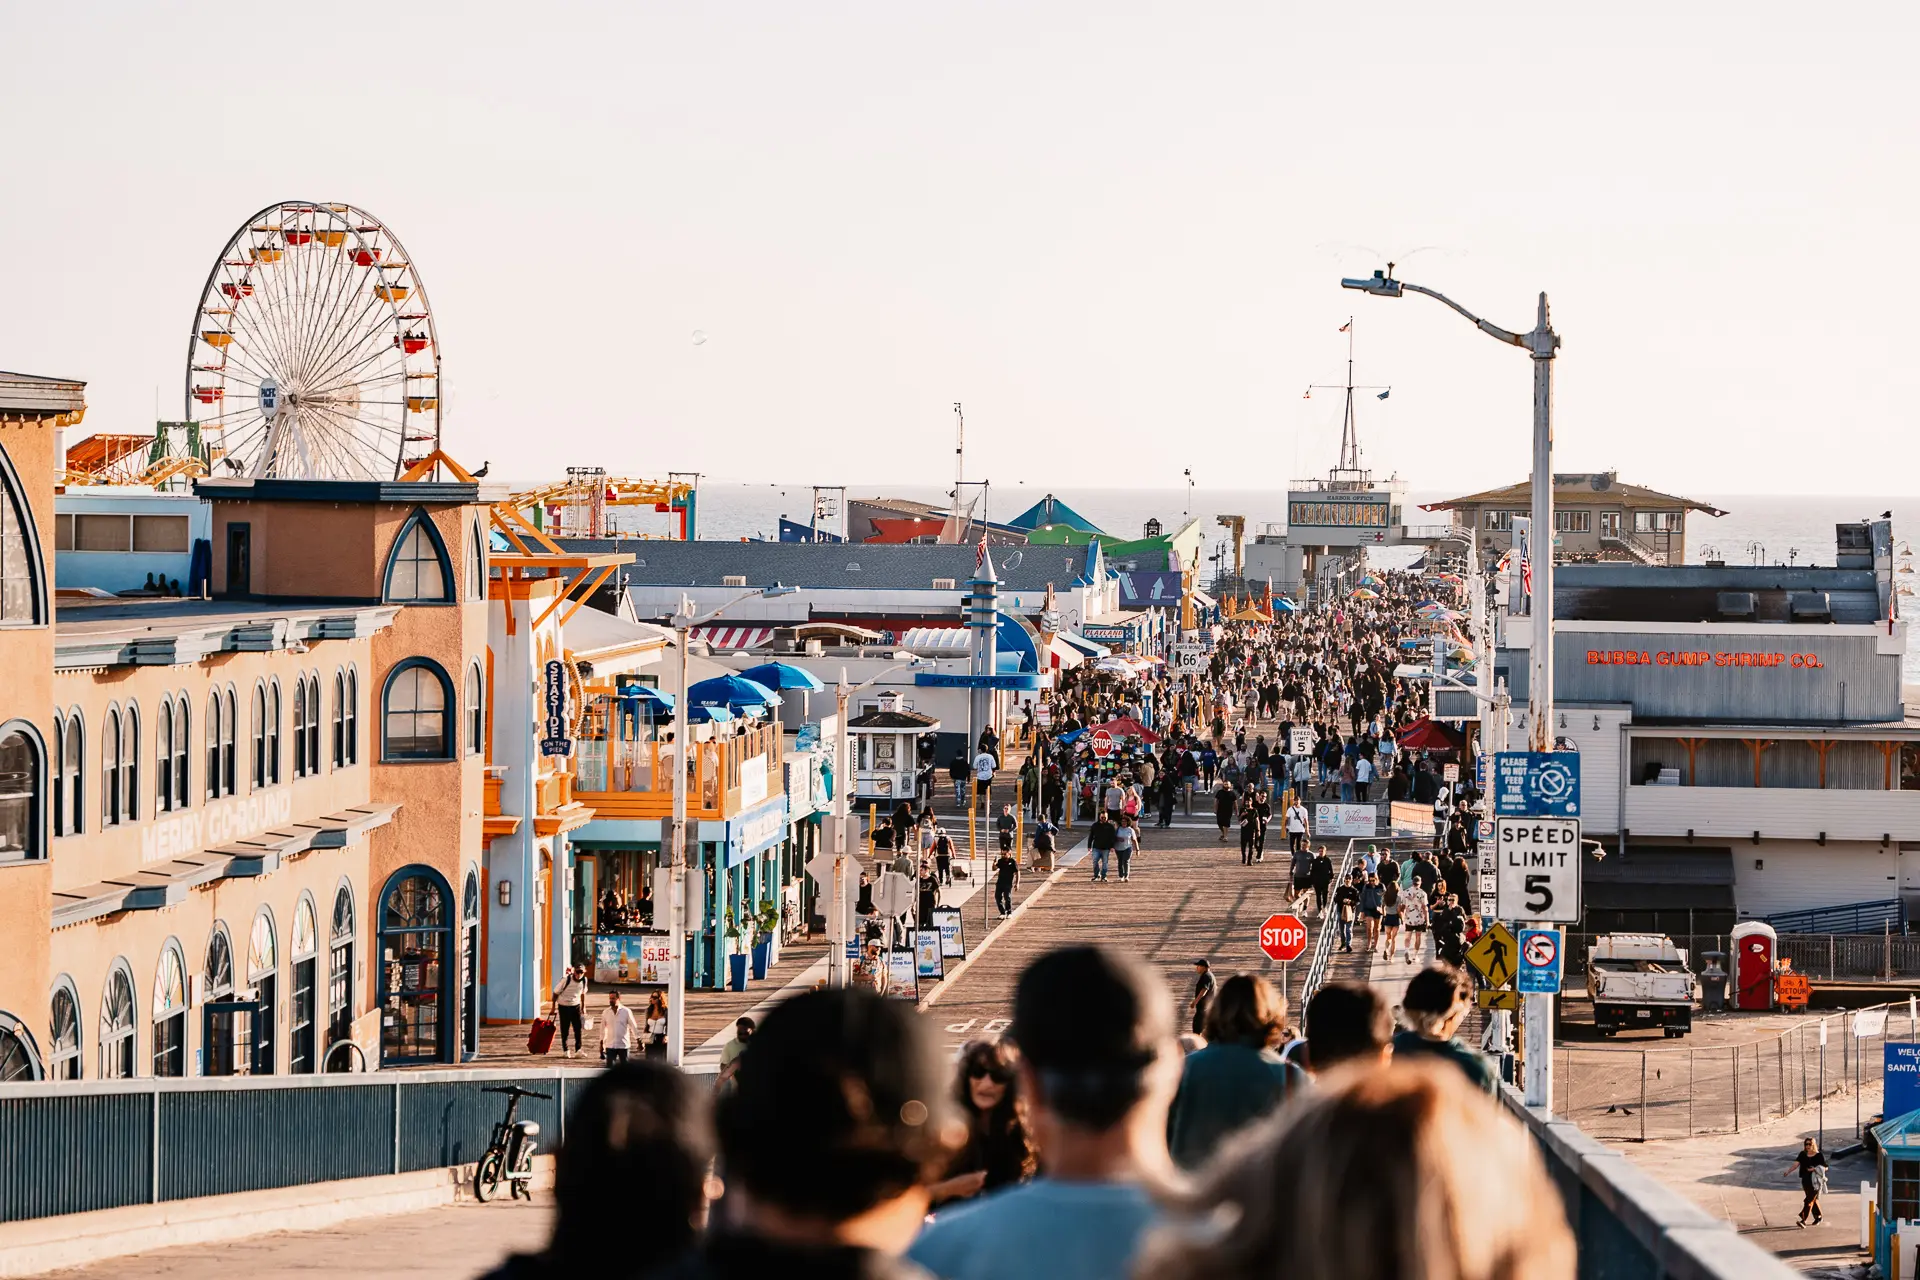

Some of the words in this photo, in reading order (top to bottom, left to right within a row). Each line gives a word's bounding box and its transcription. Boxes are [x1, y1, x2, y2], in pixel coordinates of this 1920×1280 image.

[1183, 654, 1197, 666] 66
[1587, 651, 1651, 665] BUBBA
[1656, 652, 1710, 666] GUMP
[1715, 652, 1785, 667] SHRIMP
[1790, 654, 1824, 668] CO.
[549, 663, 560, 738] SEASIDE
[555, 740, 568, 748] THE
[1093, 739, 1112, 750] STOP
[1297, 742, 1306, 752] 5
[1501, 758, 1528, 766] PLEASE
[1501, 767, 1511, 775] DO
[1513, 767, 1527, 775] NOT
[1505, 776, 1524, 785] FEED
[1507, 785, 1521, 794] THE
[1502, 795, 1527, 803] BIRDS.
[1344, 809, 1374, 824] Welcome
[142, 810, 206, 864] MERRY
[208, 789, 292, 844] GO-ROUND
[1502, 827, 1575, 844] SPEED
[1484, 858, 1491, 868] 5
[1509, 851, 1568, 867] LIMIT
[1524, 874, 1553, 913] 5
[1485, 906, 1491, 914] 3
[1262, 928, 1304, 947] STOP
[642, 948, 670, 961] $5.95
[1780, 987, 1807, 995] DETOUR
[1887, 1064, 1917, 1072] SANTA
